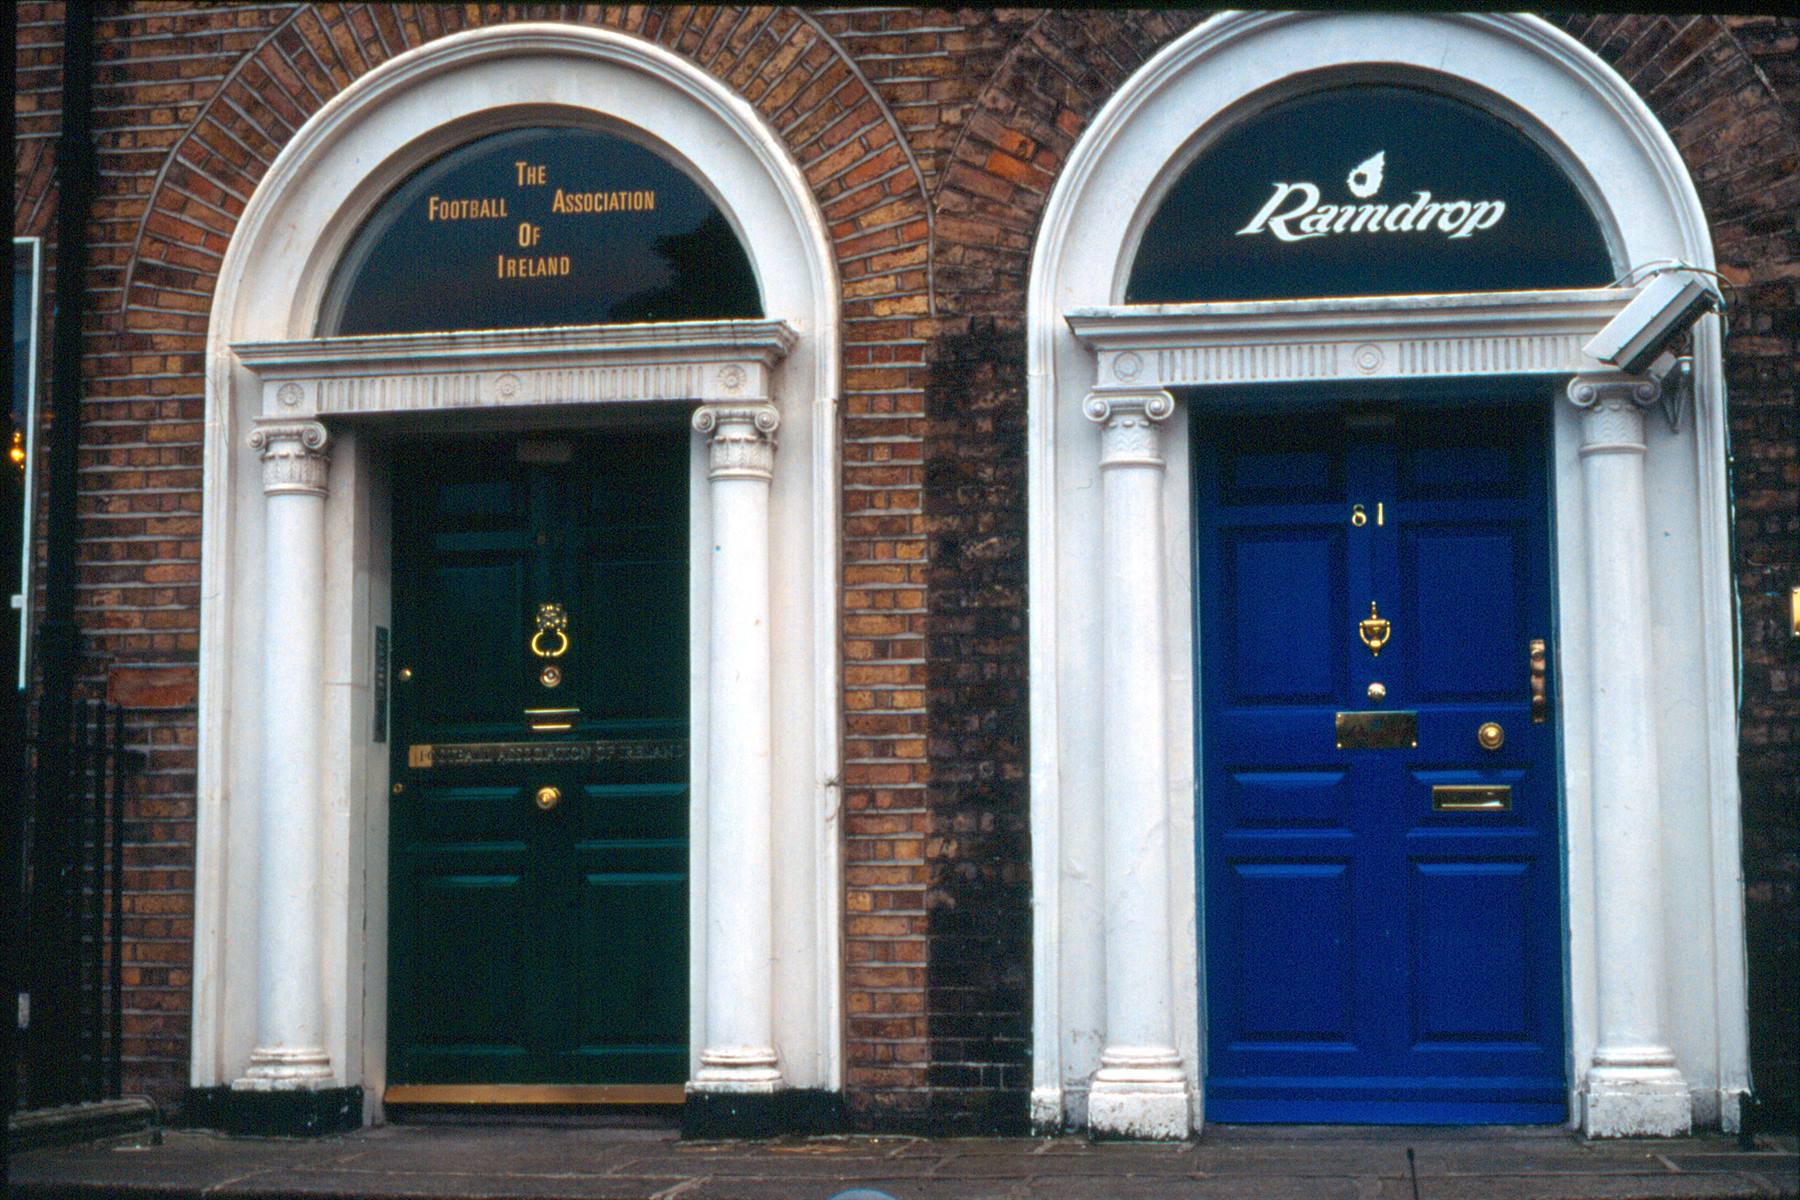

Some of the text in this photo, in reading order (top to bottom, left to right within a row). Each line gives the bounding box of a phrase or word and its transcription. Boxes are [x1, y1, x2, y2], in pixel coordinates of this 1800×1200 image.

[515, 161, 546, 186] THE
[428, 188, 655, 221] FOOTBALL ASSOCIATION
[1235, 182, 1506, 242] Raindrop
[519, 222, 541, 247] OF
[498, 255, 571, 279] IRELAND
[1351, 502, 1384, 527] 81
